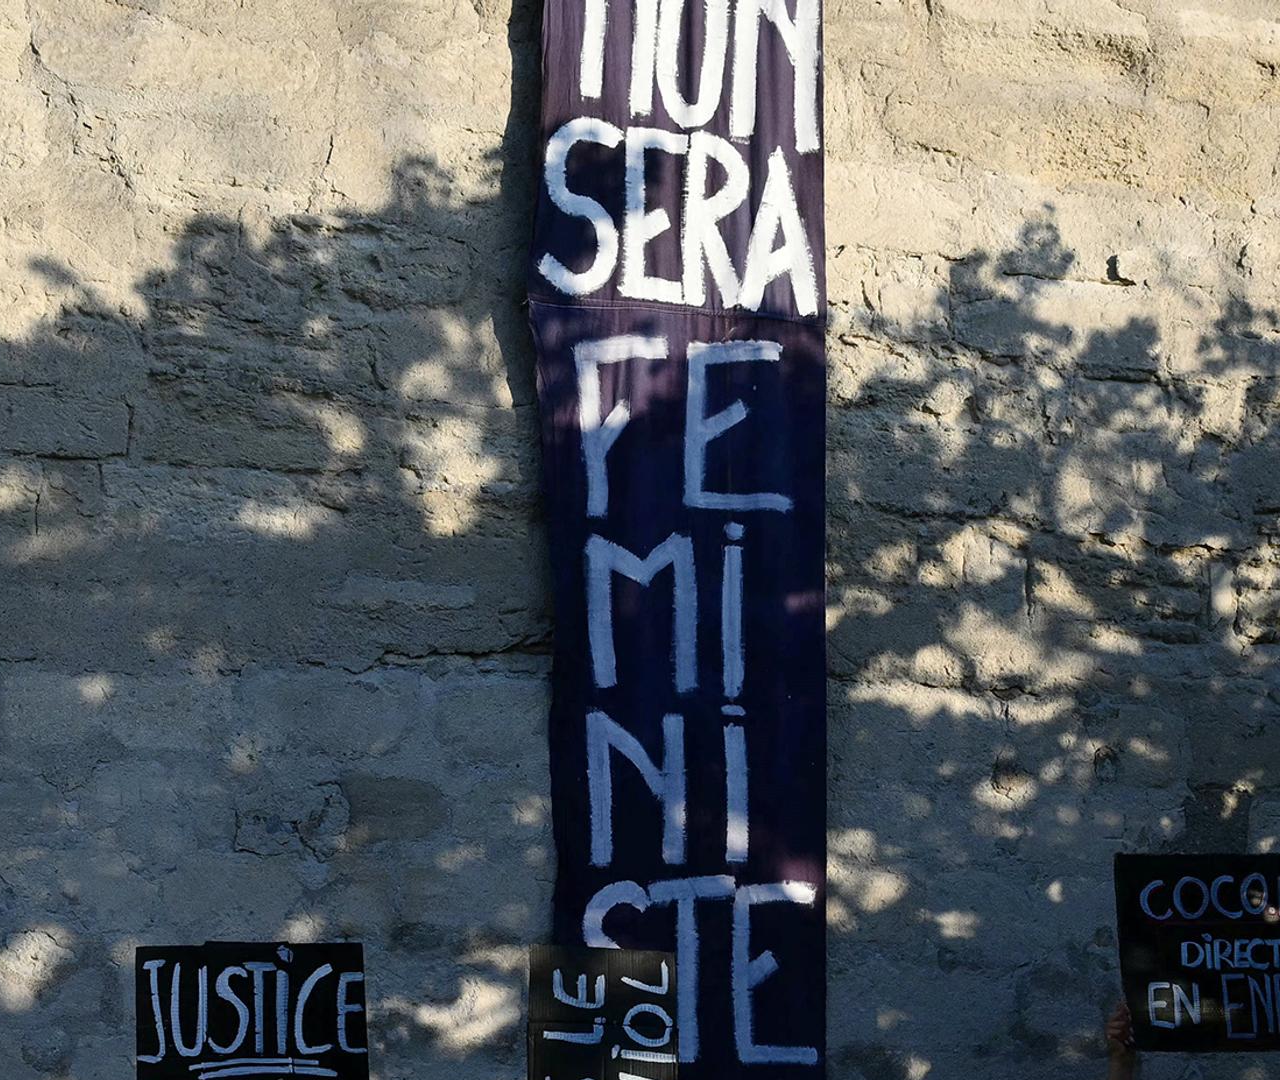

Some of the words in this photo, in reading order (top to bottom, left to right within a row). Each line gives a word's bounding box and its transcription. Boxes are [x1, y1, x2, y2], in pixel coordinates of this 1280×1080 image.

[538, 116, 818, 317] SERA
[574, 335, 793, 517] FE
[585, 522, 745, 698] MI
[585, 705, 750, 867] NI
[137, 945, 367, 1063] JUSTICE
[542, 969, 606, 1044] LE
[1148, 981, 1201, 1029] EN
